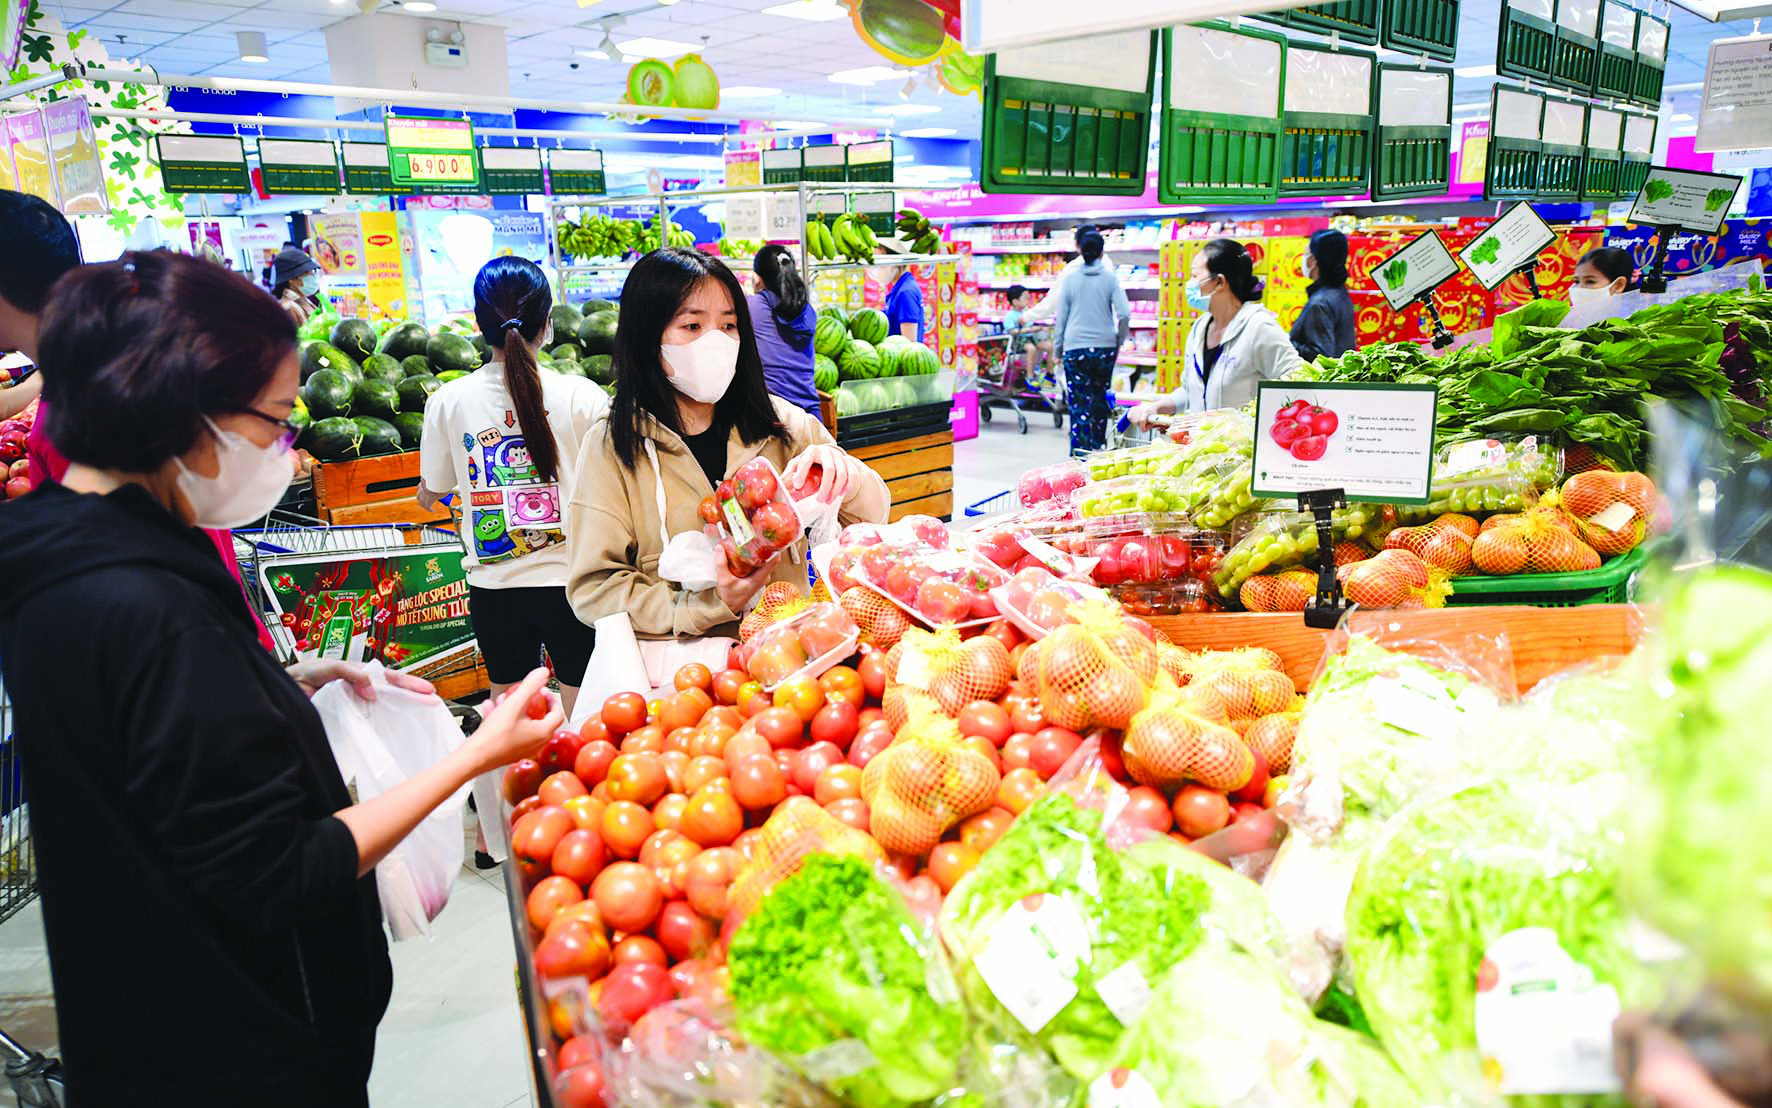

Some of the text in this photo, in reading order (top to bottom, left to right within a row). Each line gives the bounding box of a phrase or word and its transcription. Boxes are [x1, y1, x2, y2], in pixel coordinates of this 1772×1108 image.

[412, 157, 458, 174] 6.900
[429, 579, 470, 603] SPECIAL
[421, 603, 447, 622] SUNG
[447, 597, 470, 618] TÚC
